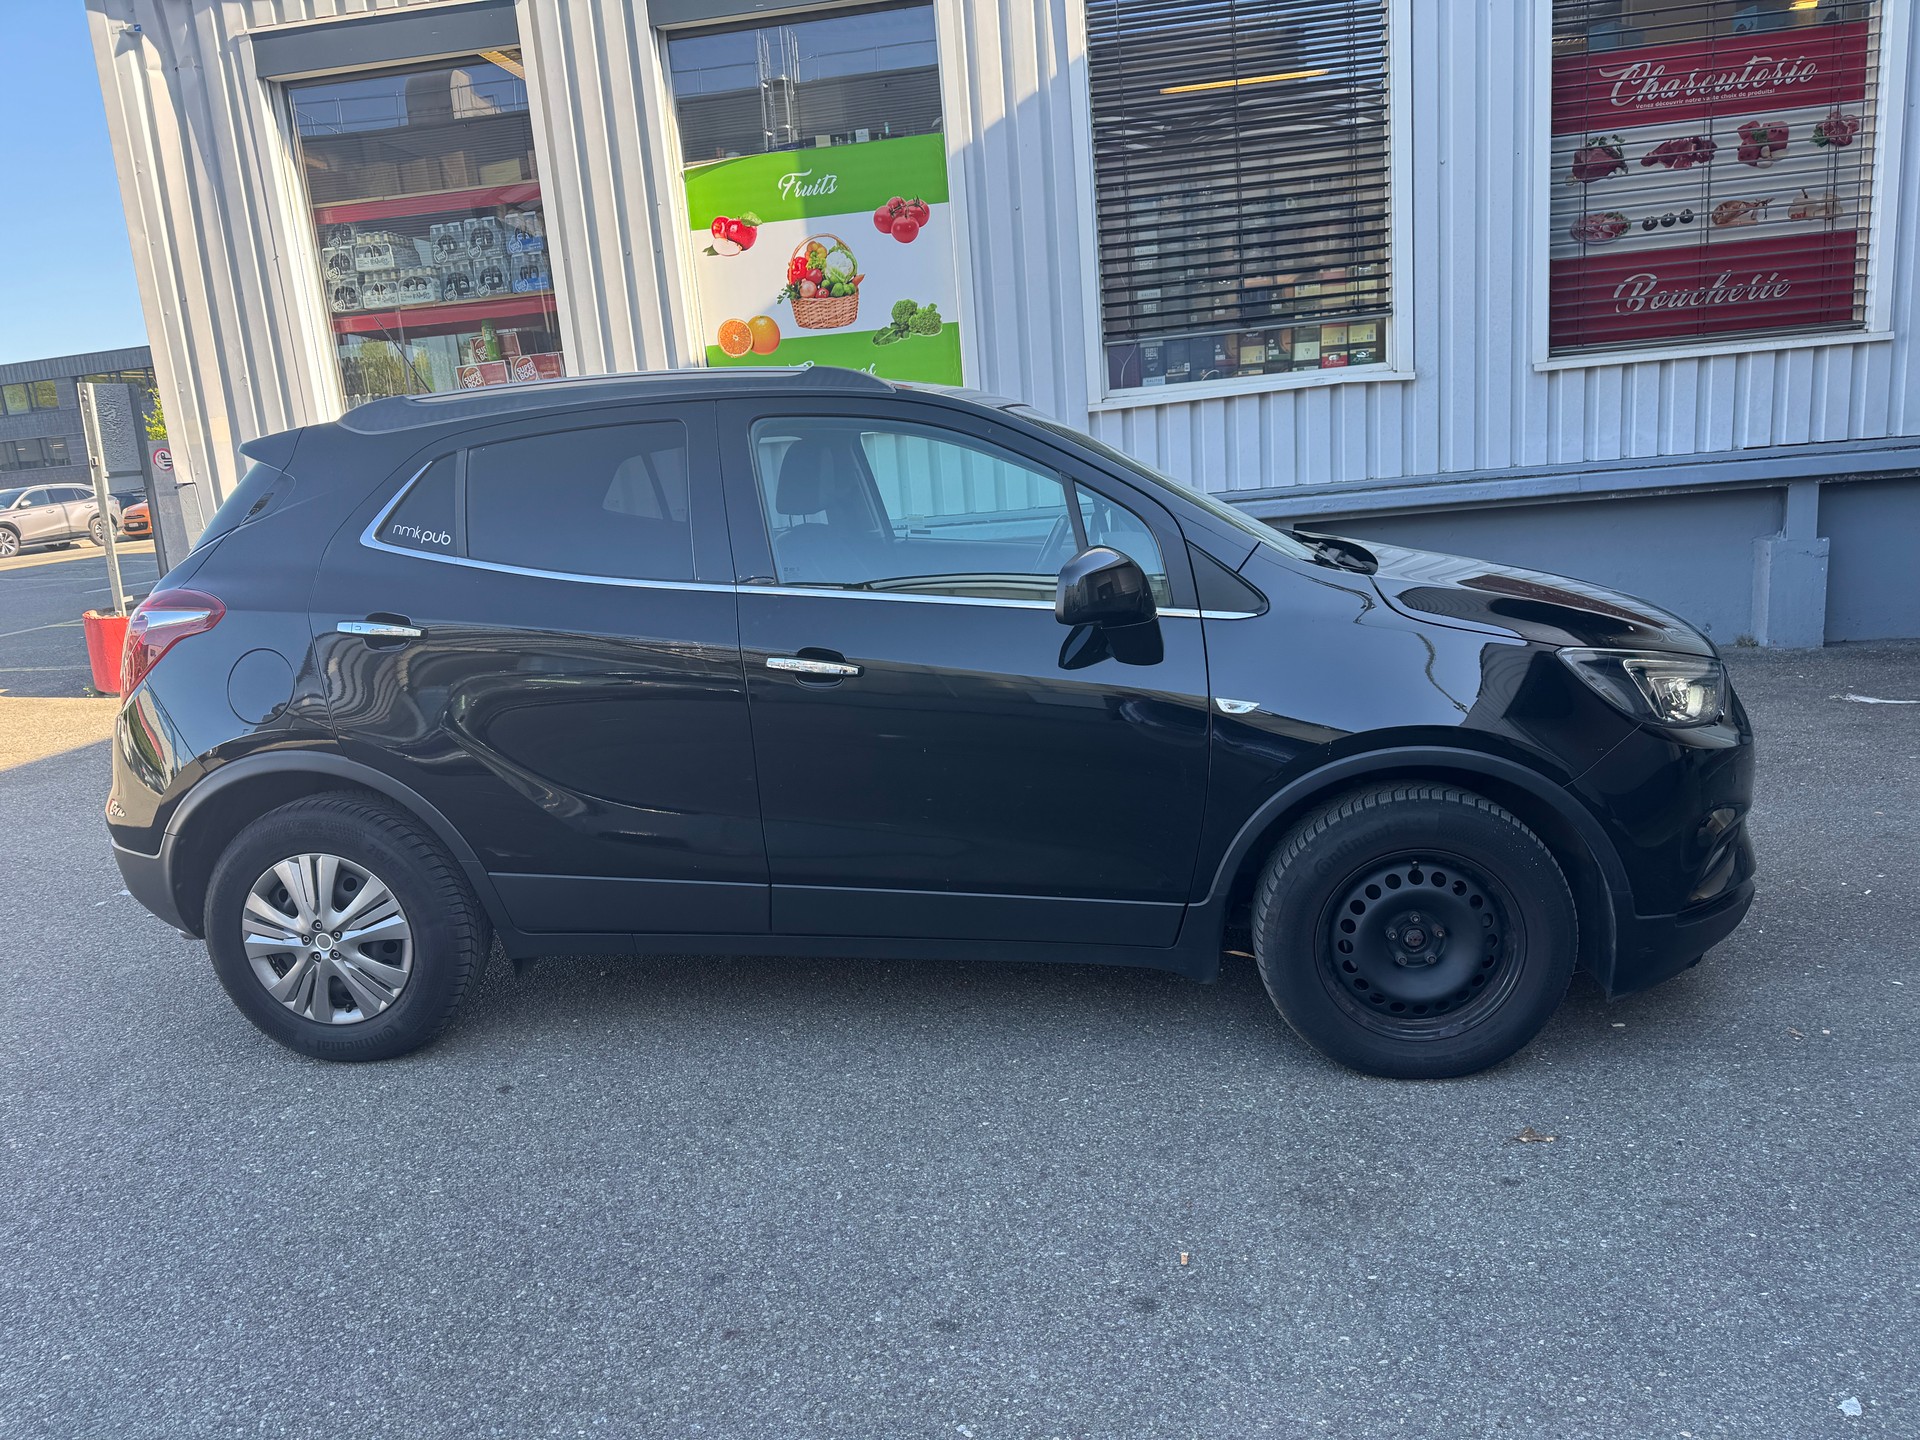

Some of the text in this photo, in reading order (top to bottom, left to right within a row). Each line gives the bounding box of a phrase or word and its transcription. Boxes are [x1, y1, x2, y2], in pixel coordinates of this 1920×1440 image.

[1599, 56, 1818, 106] Charcuterie
[1655, 98, 1684, 107] découvrir
[777, 169, 838, 201] Fruits
[1613, 270, 1791, 316] Boucherie
[516, 361, 534, 374] SUPER
